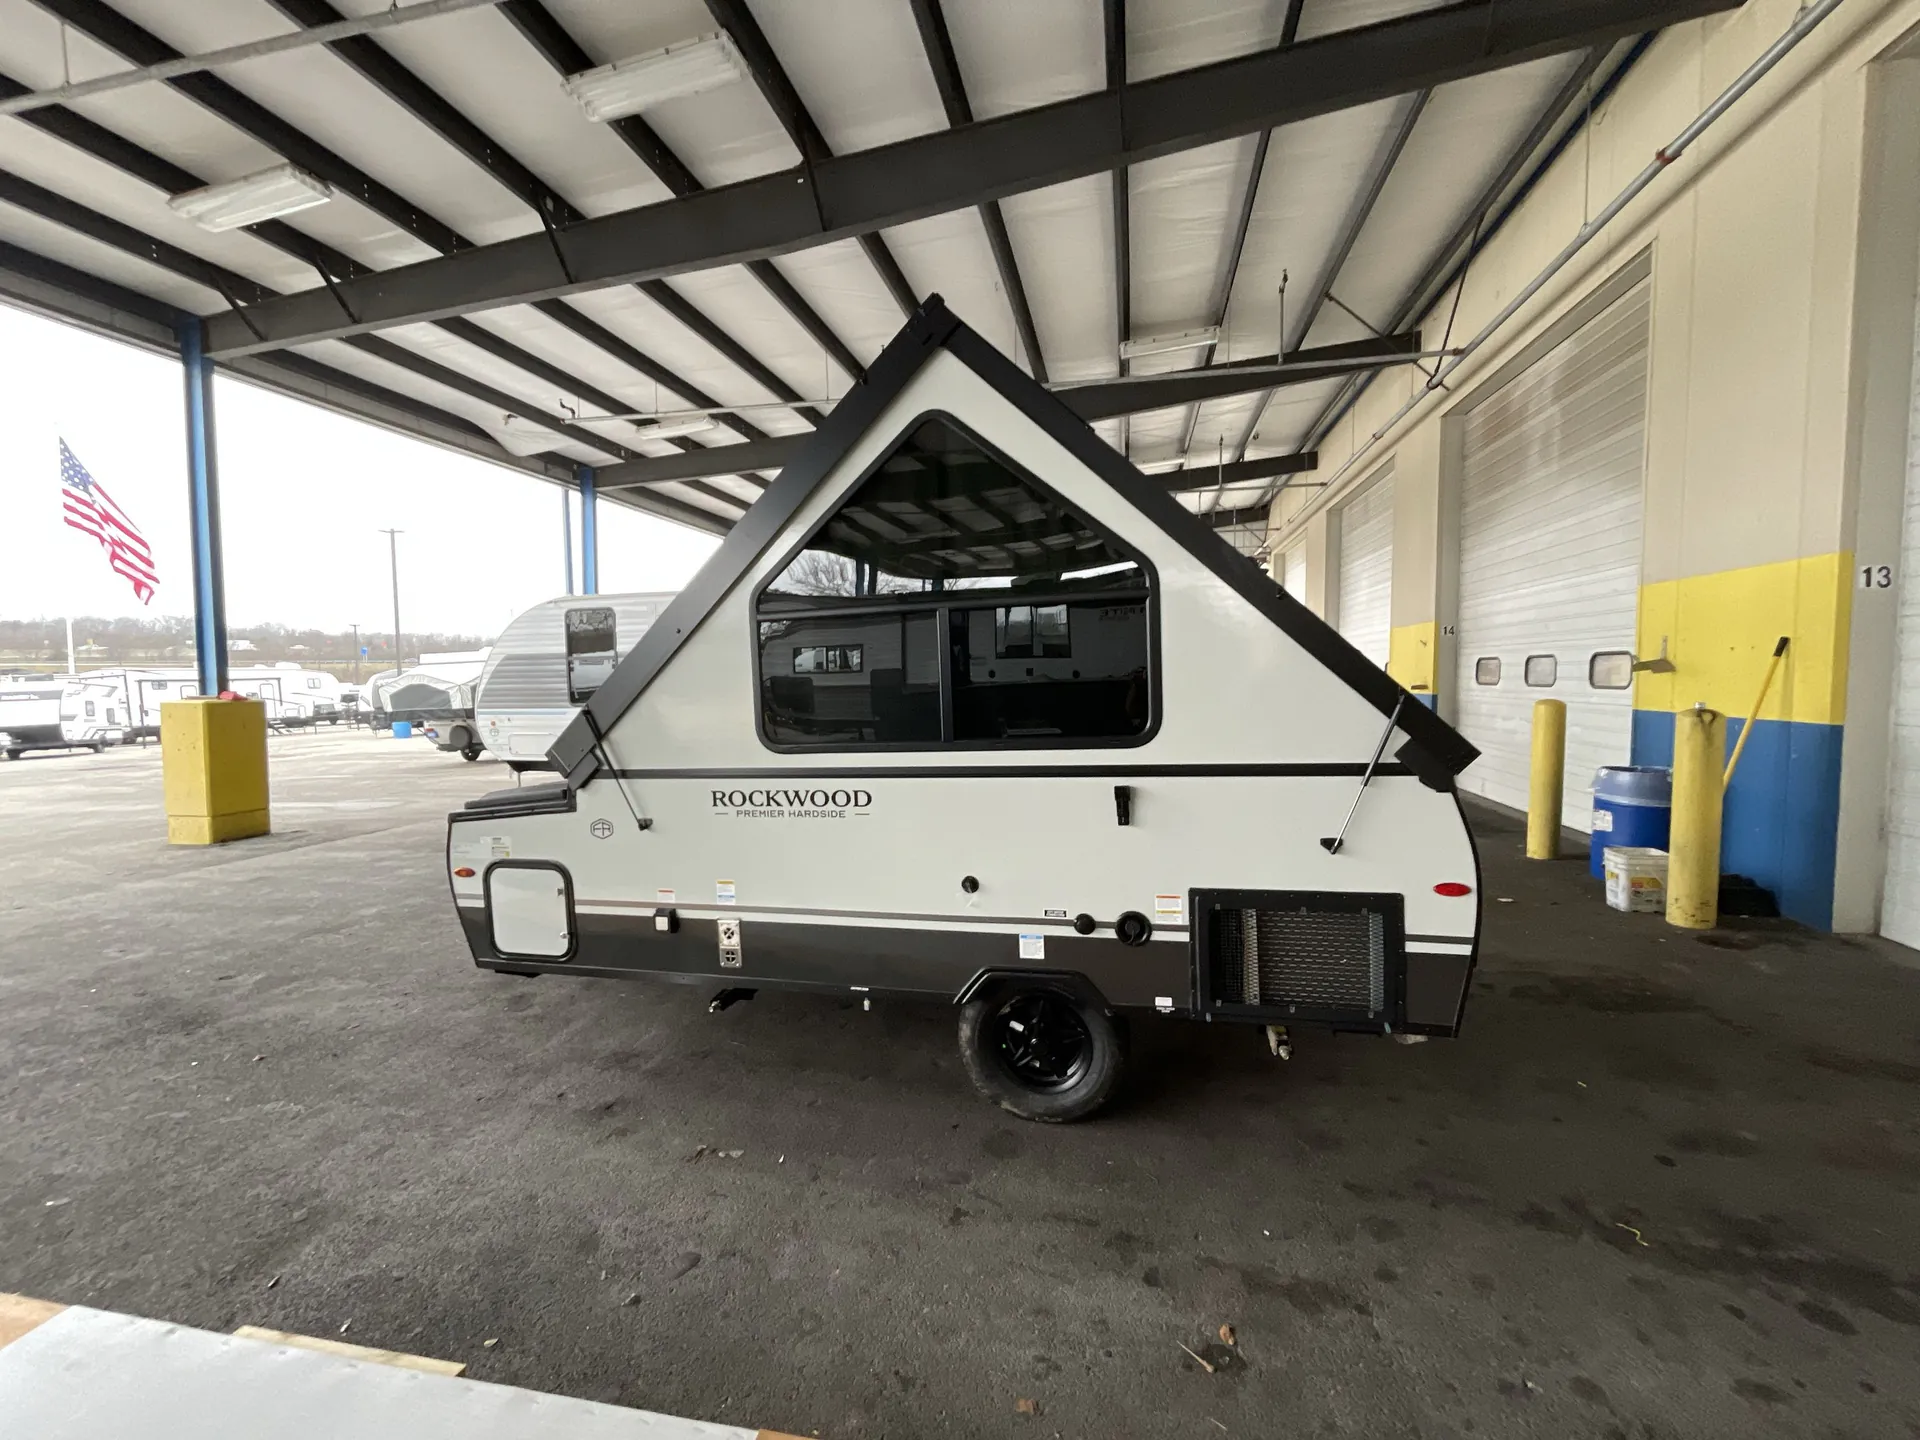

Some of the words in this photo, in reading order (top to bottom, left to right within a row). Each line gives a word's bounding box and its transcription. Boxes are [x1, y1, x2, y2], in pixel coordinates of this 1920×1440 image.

[1862, 565, 1892, 589] 13
[1443, 625, 1455, 636] 14
[711, 789, 873, 808] ROCKWOOD
[736, 809, 785, 818] PREMIER
[788, 809, 846, 818] HARDSIDE
